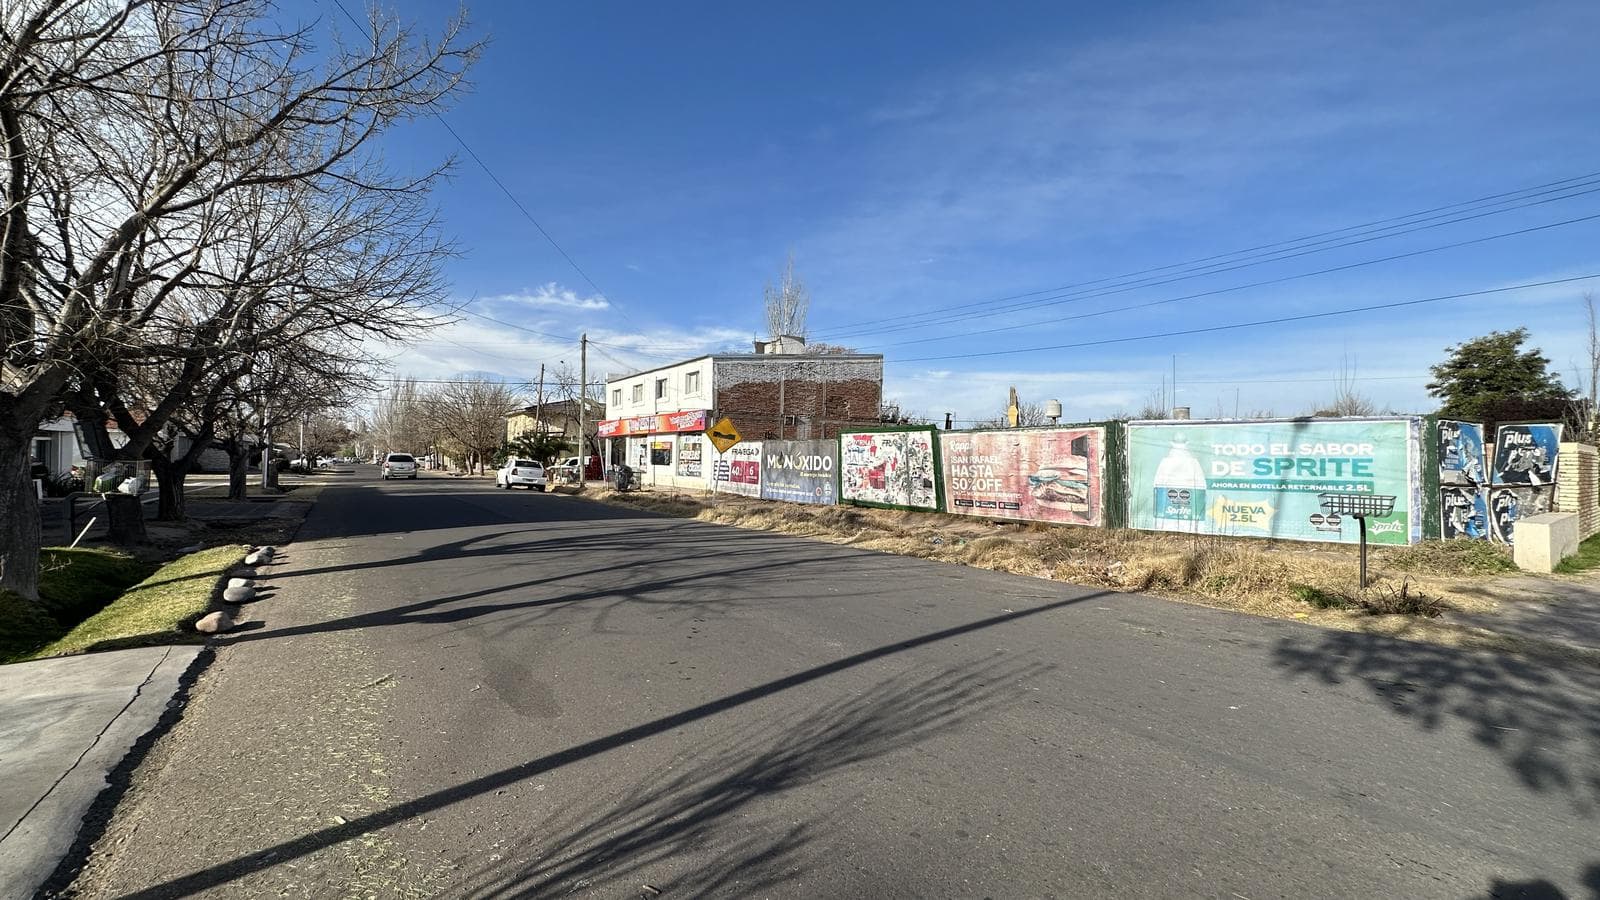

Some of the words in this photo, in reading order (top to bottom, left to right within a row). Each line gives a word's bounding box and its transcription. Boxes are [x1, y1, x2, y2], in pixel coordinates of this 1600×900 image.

[1504, 432, 1532, 448] plus
[1211, 443, 1264, 456] TODO
[1270, 443, 1295, 456] EL
[1299, 443, 1375, 456] SABOR
[951, 456, 968, 464] SAN
[969, 456, 1001, 464] RAFAEL
[951, 464, 993, 478] HASTA
[1212, 460, 1246, 476] DE
[1252, 457, 1375, 478] SPRITE
[1345, 484, 1372, 492] 2.5L
[1221, 505, 1266, 515] NUEVA
[1229, 514, 1257, 523] 2.5L
